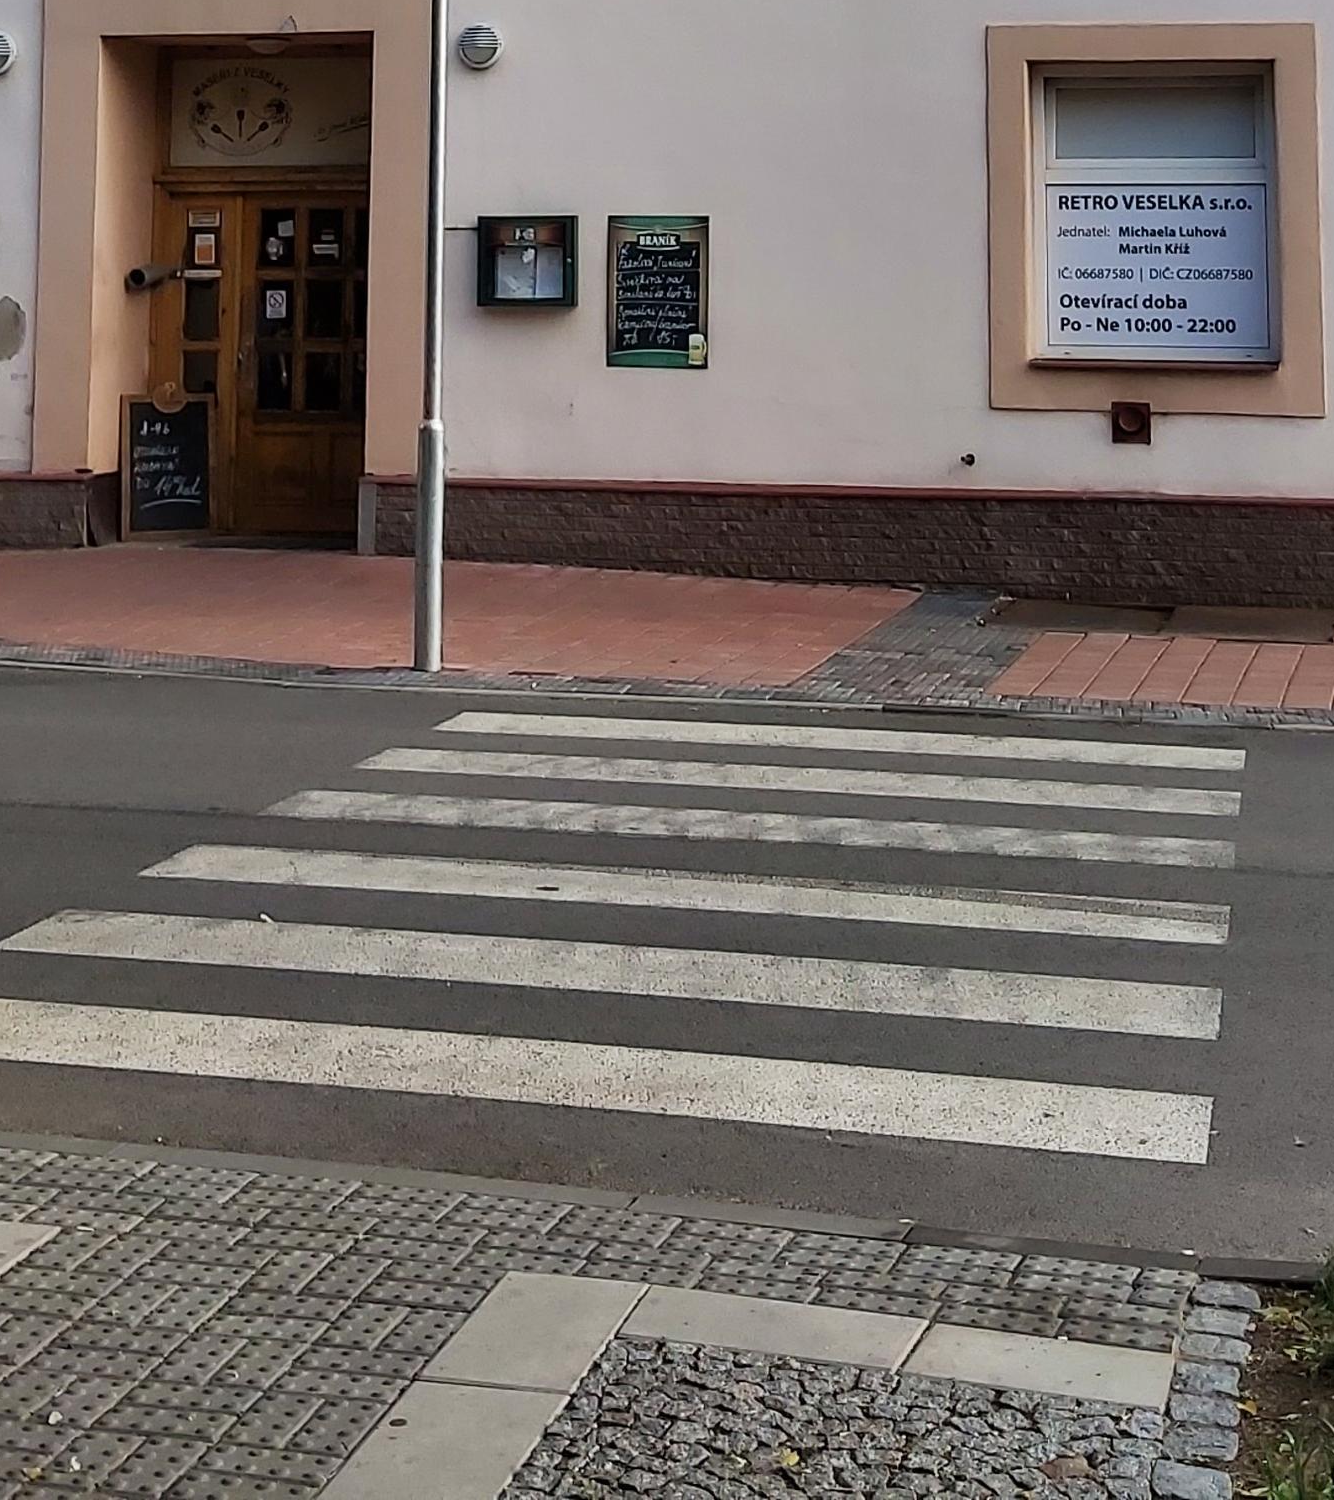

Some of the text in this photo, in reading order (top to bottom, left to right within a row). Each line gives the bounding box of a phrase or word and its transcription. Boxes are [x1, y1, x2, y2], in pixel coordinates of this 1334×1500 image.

[1058, 195, 1253, 211] RETRO VESELKA s.r.o.
[1057, 226, 1227, 238] Jednatel: Michaela Luhová
[639, 233, 677, 246] BRANÍK
[1118, 243, 1191, 255] Martin Kříž
[1075, 268, 1134, 280] 06687580
[1176, 269, 1254, 280] CZ06687580
[1060, 294, 1188, 309] Otevírací doba
[1060, 318, 1082, 332] Po
[1096, 318, 1120, 332] Ne
[1125, 319, 1173, 333] 10:00
[1187, 319, 1237, 334] 22:00
